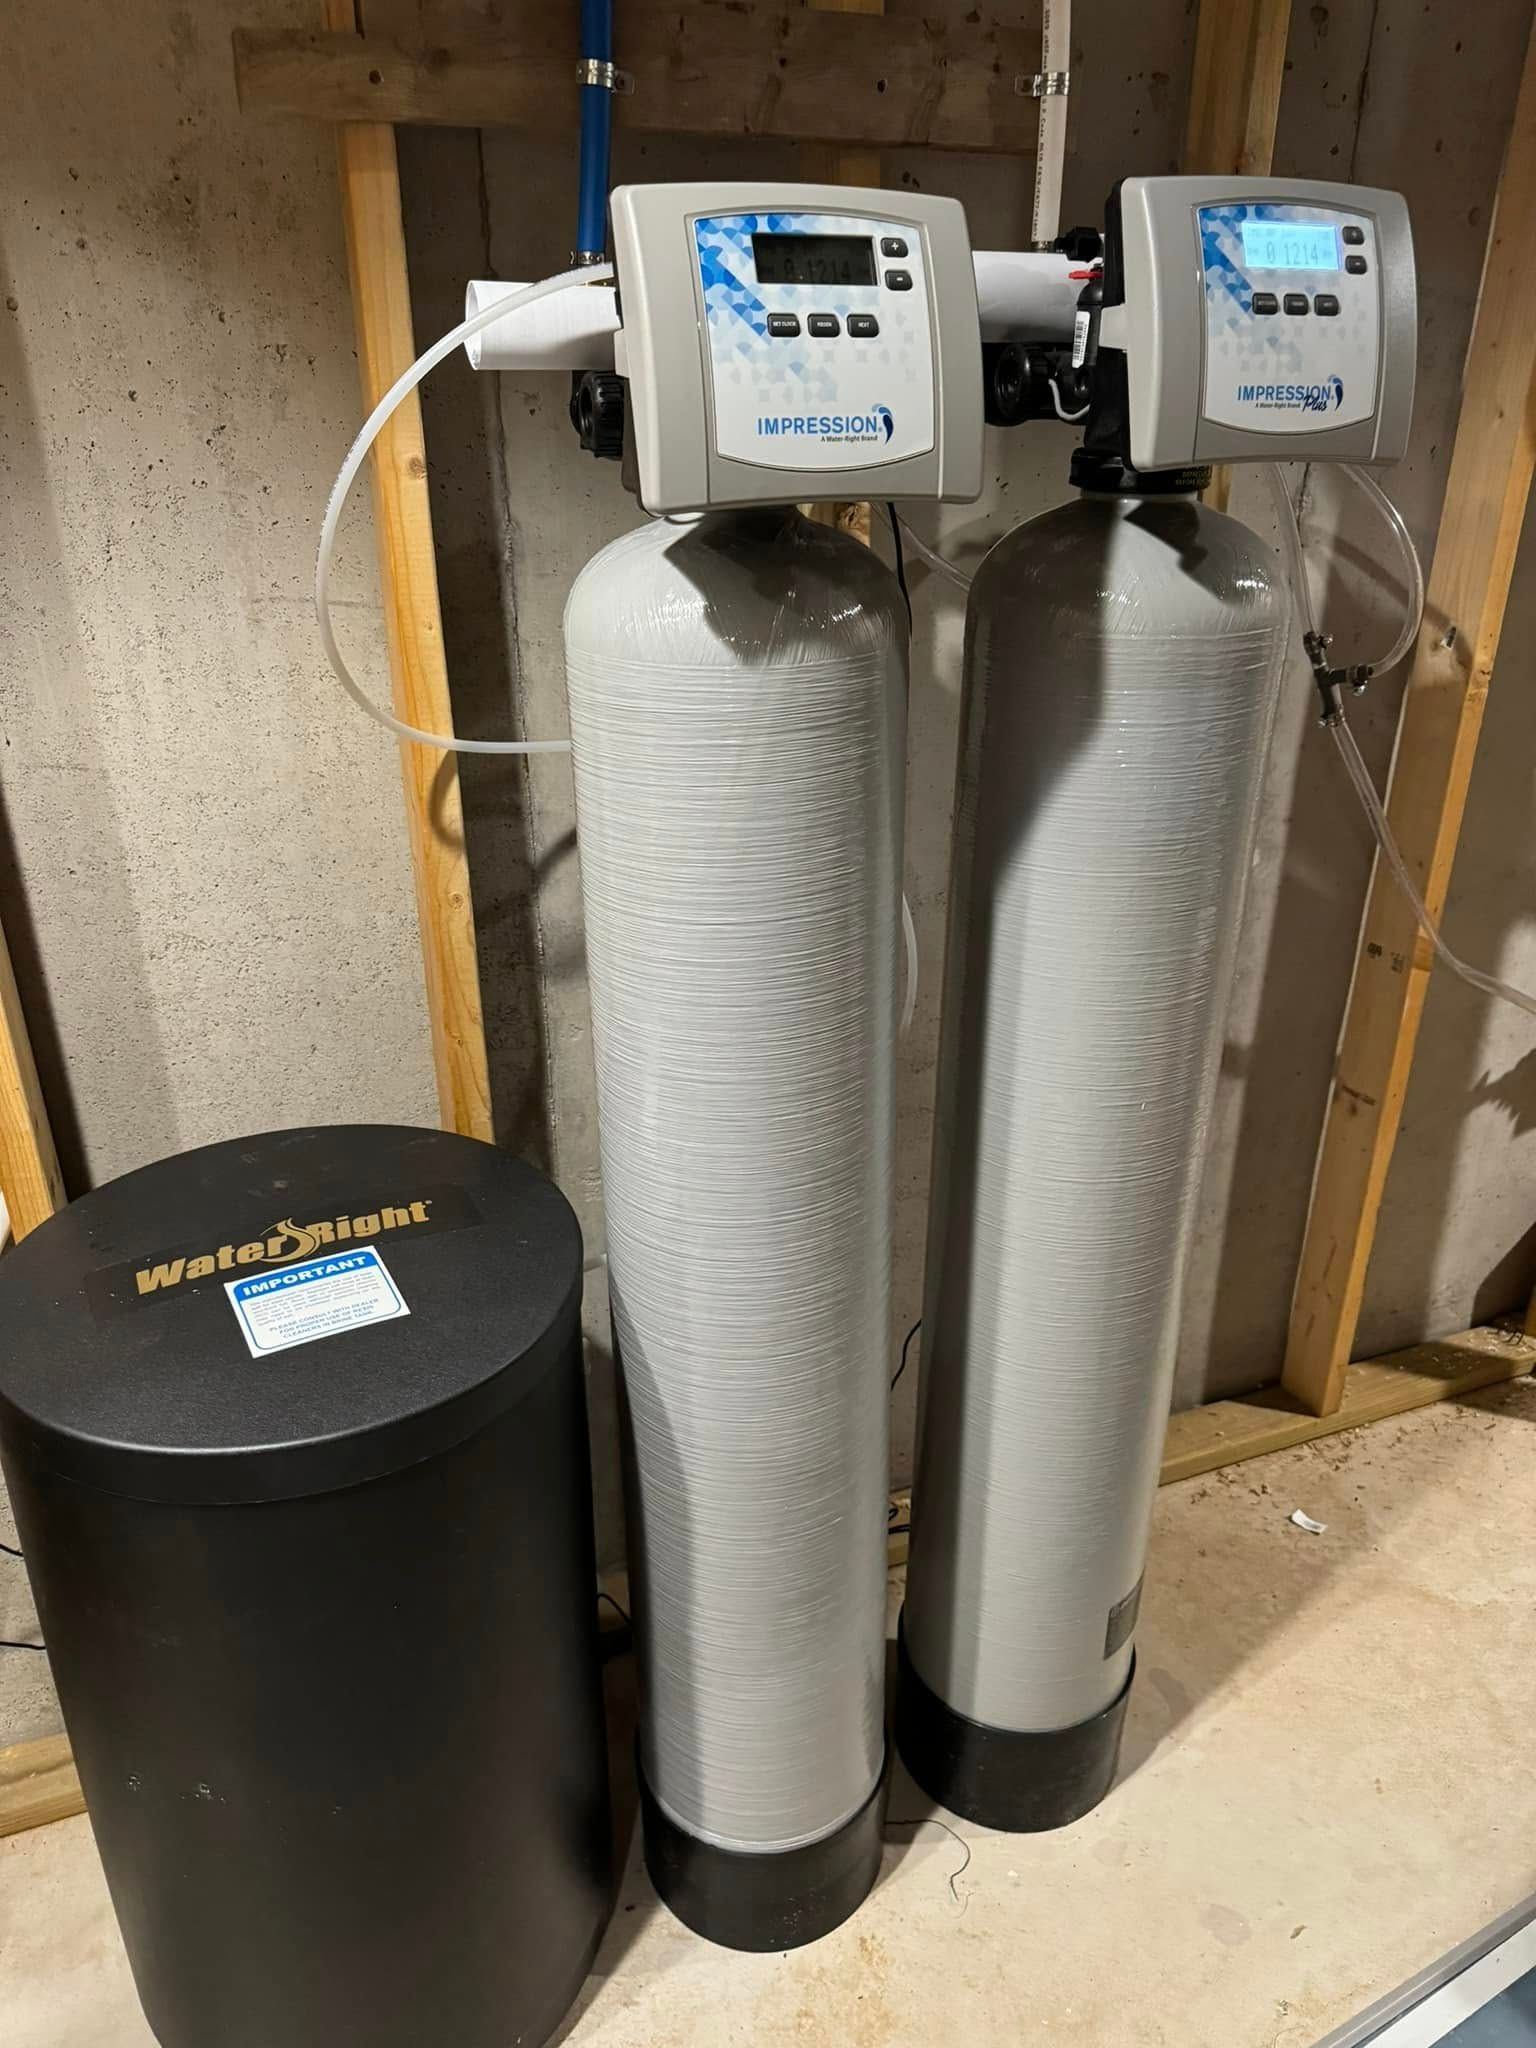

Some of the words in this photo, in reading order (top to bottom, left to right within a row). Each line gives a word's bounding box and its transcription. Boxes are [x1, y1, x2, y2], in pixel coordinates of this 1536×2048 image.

[1237, 384, 1331, 401] IMPRESSION
[1302, 393, 1328, 413] Plus
[757, 416, 878, 435] IMPRESSION
[242, 1255, 367, 1297] IMPORTANT
